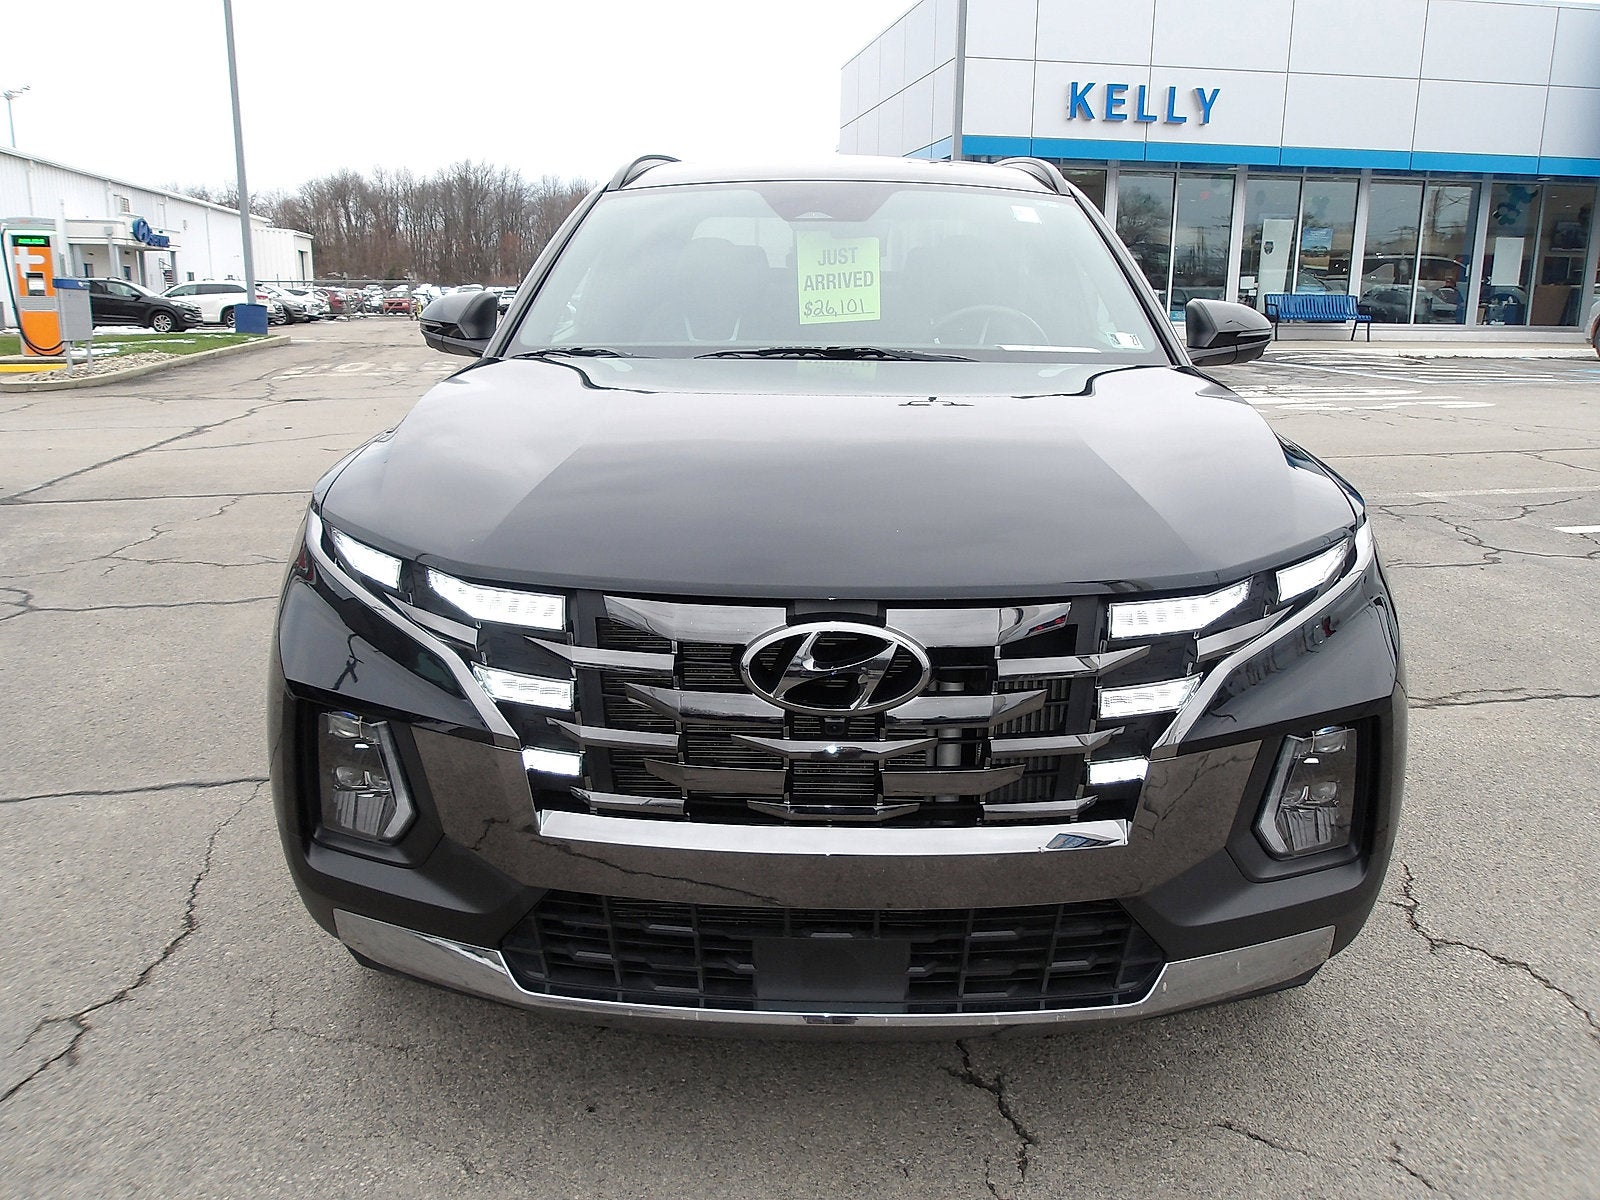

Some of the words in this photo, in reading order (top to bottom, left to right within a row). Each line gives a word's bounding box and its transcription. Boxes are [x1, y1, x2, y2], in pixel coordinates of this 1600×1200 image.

[1068, 82, 1221, 126] KELLY
[817, 247, 858, 266] JUST
[803, 270, 874, 291] ARRIVED
[804, 298, 865, 318] $26,101
